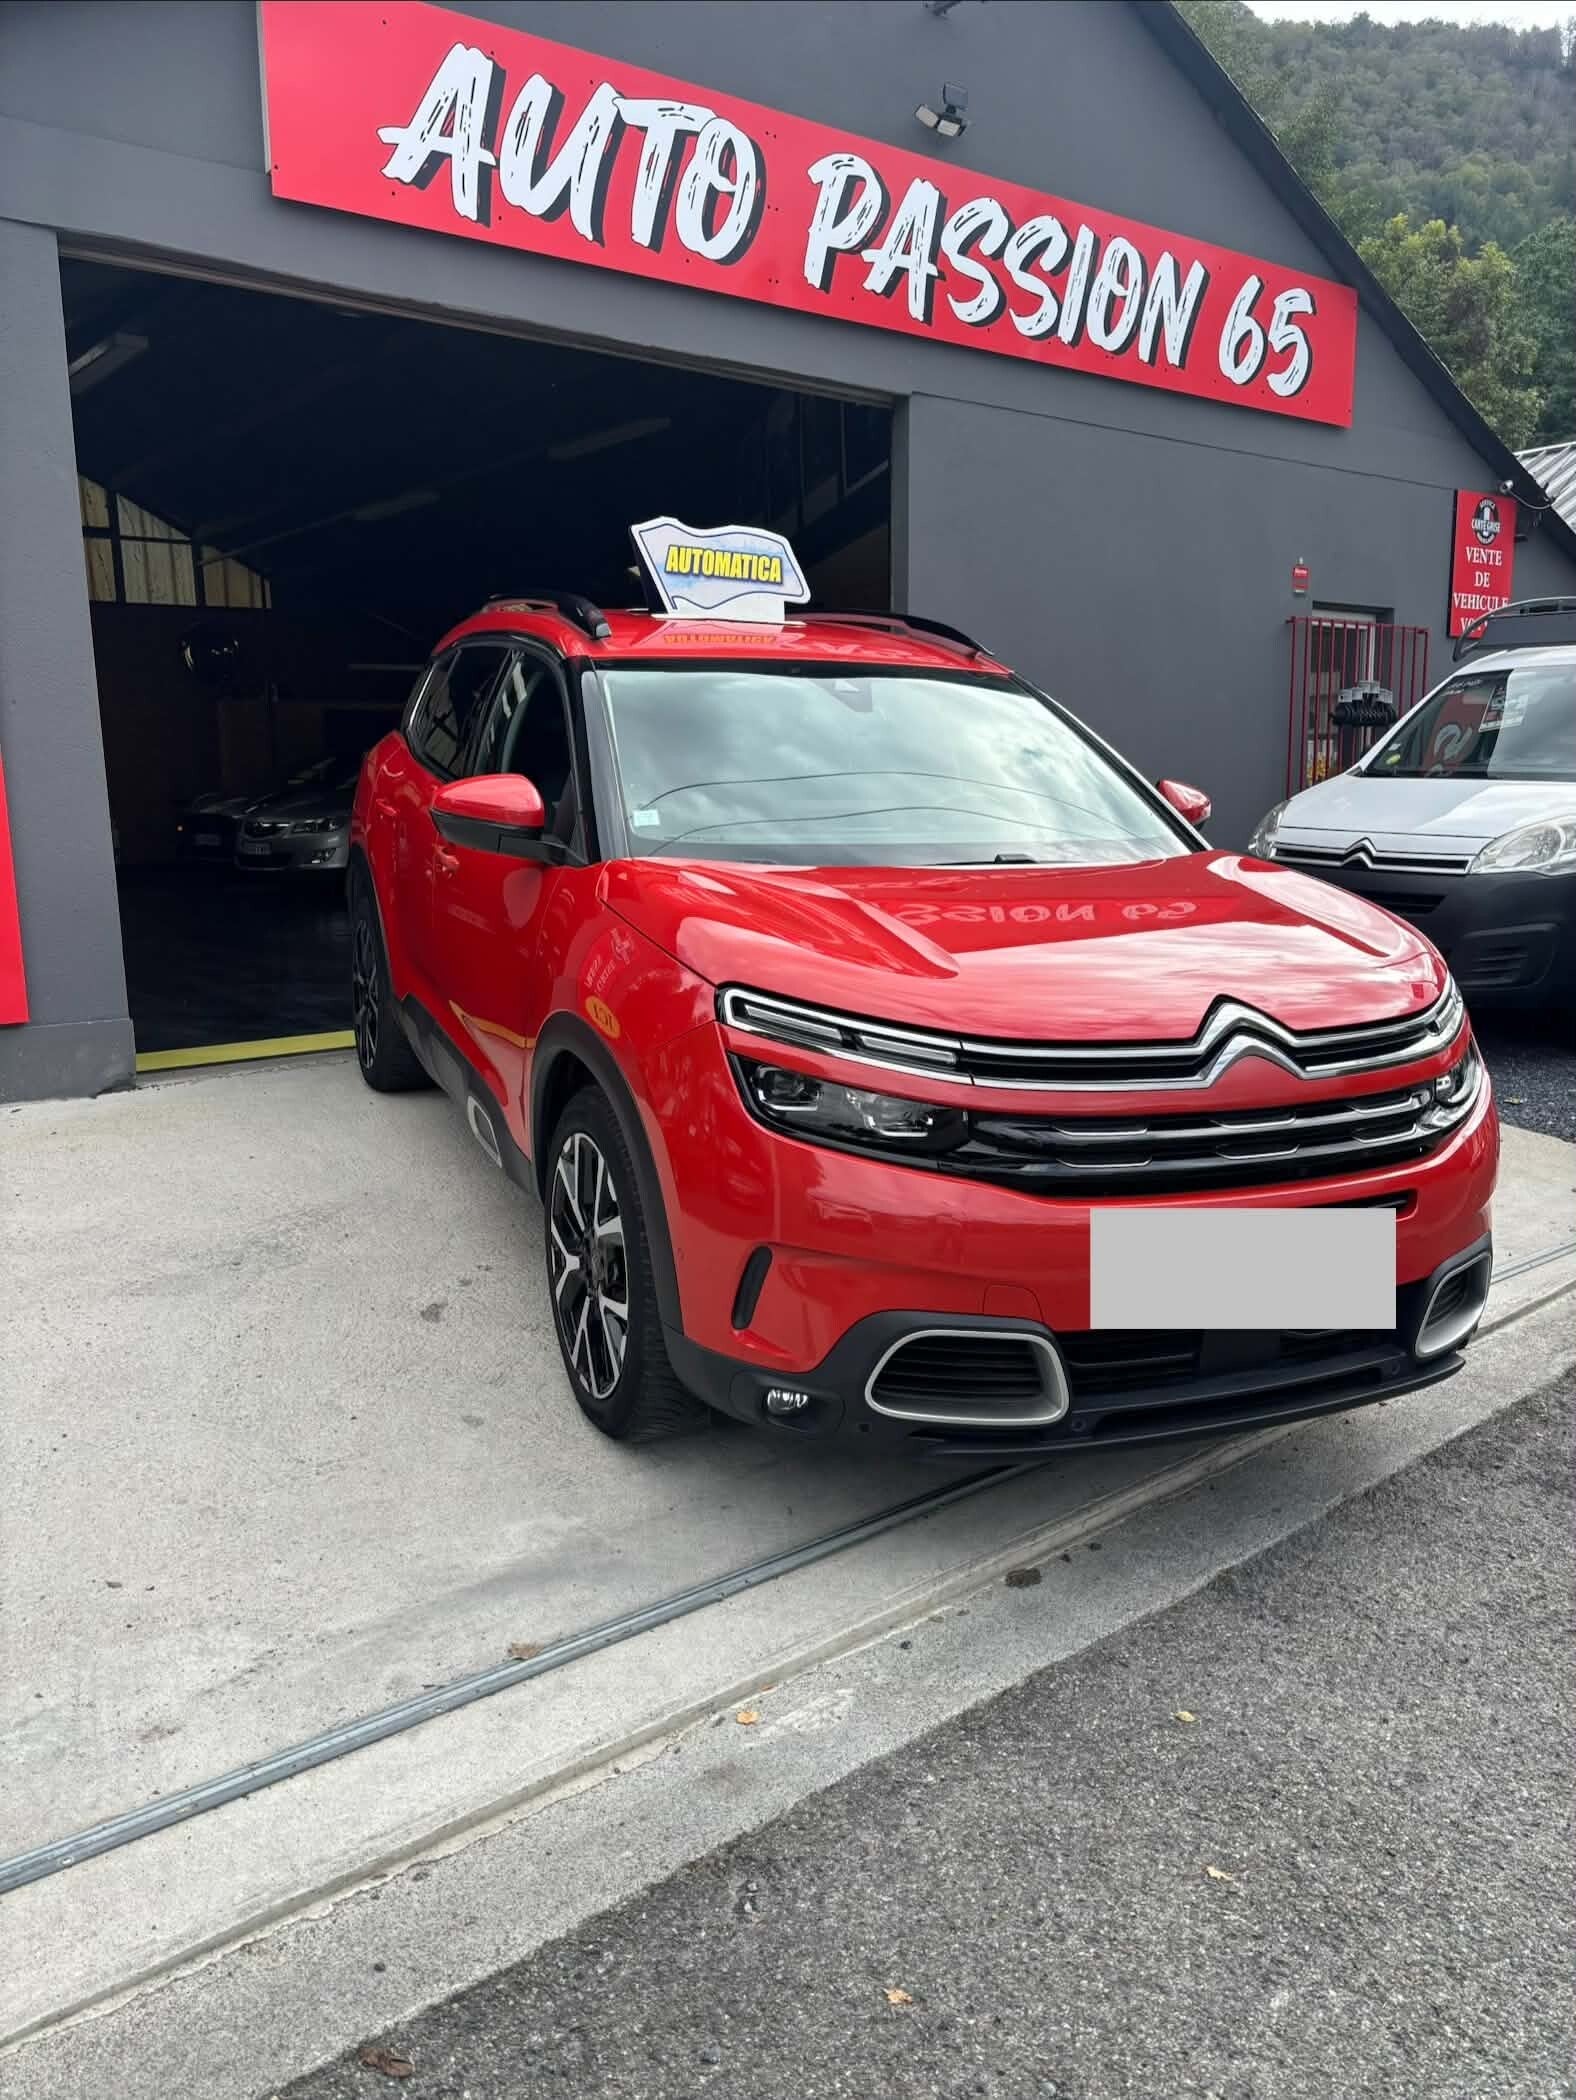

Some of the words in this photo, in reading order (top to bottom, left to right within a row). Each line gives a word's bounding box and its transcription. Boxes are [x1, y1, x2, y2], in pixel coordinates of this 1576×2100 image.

[377, 42, 765, 265] AUTO
[803, 153, 1208, 368] PASSION
[1218, 275, 1315, 397] 65
[664, 544, 783, 585] AUTOMATICA
[1466, 546, 1503, 566] VENTE
[1474, 571, 1491, 588] DE
